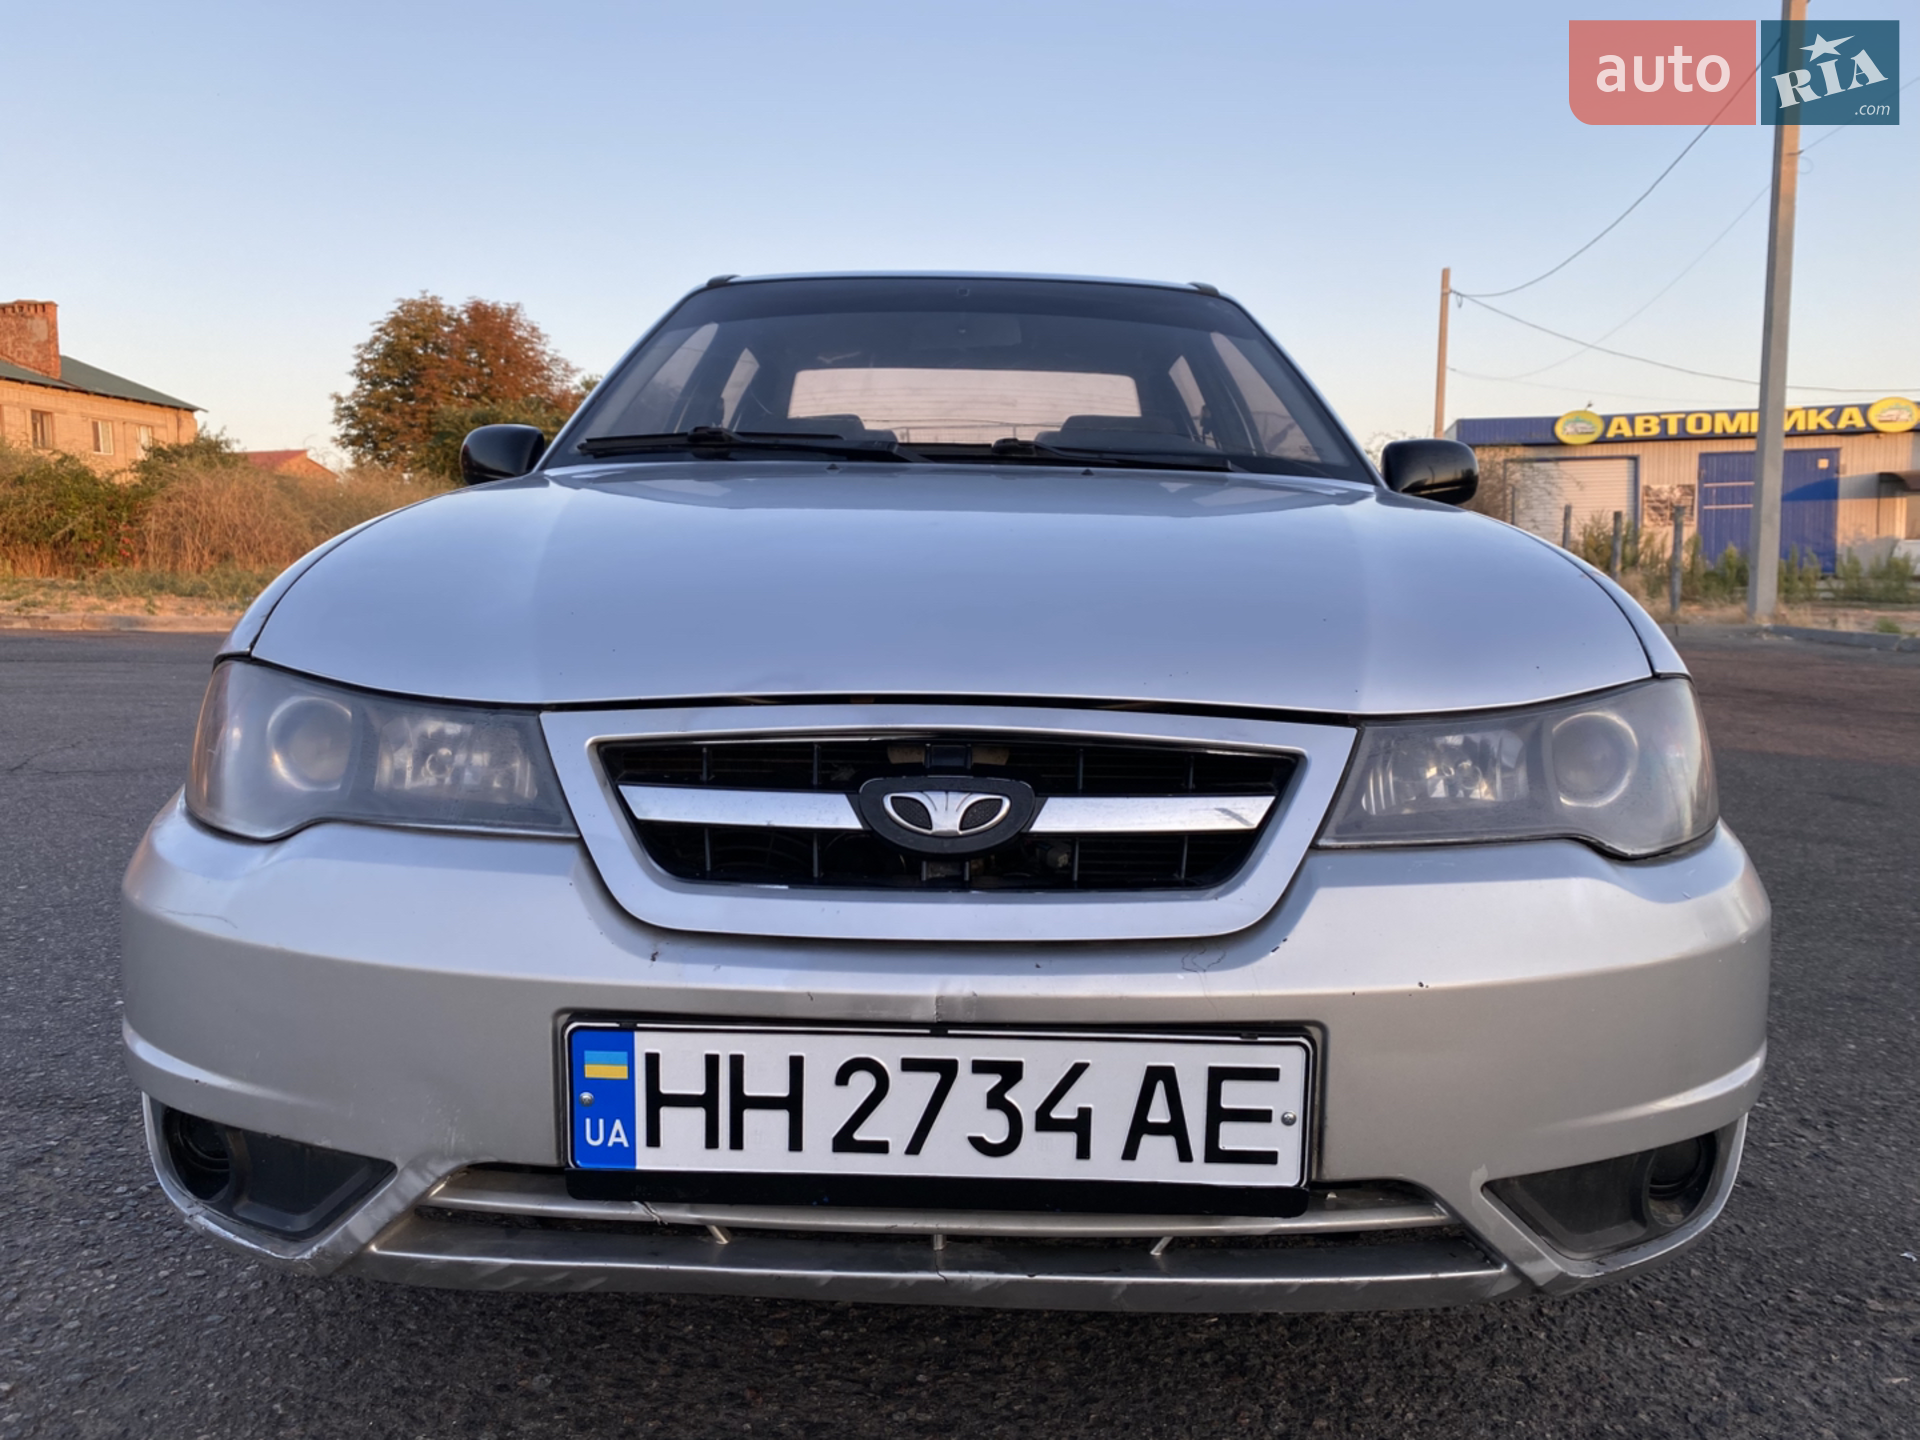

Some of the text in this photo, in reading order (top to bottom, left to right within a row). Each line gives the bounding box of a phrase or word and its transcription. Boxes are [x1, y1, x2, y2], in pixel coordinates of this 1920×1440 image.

[584, 1118, 629, 1149] UA
[645, 1052, 1280, 1165] HH 2734 AE
